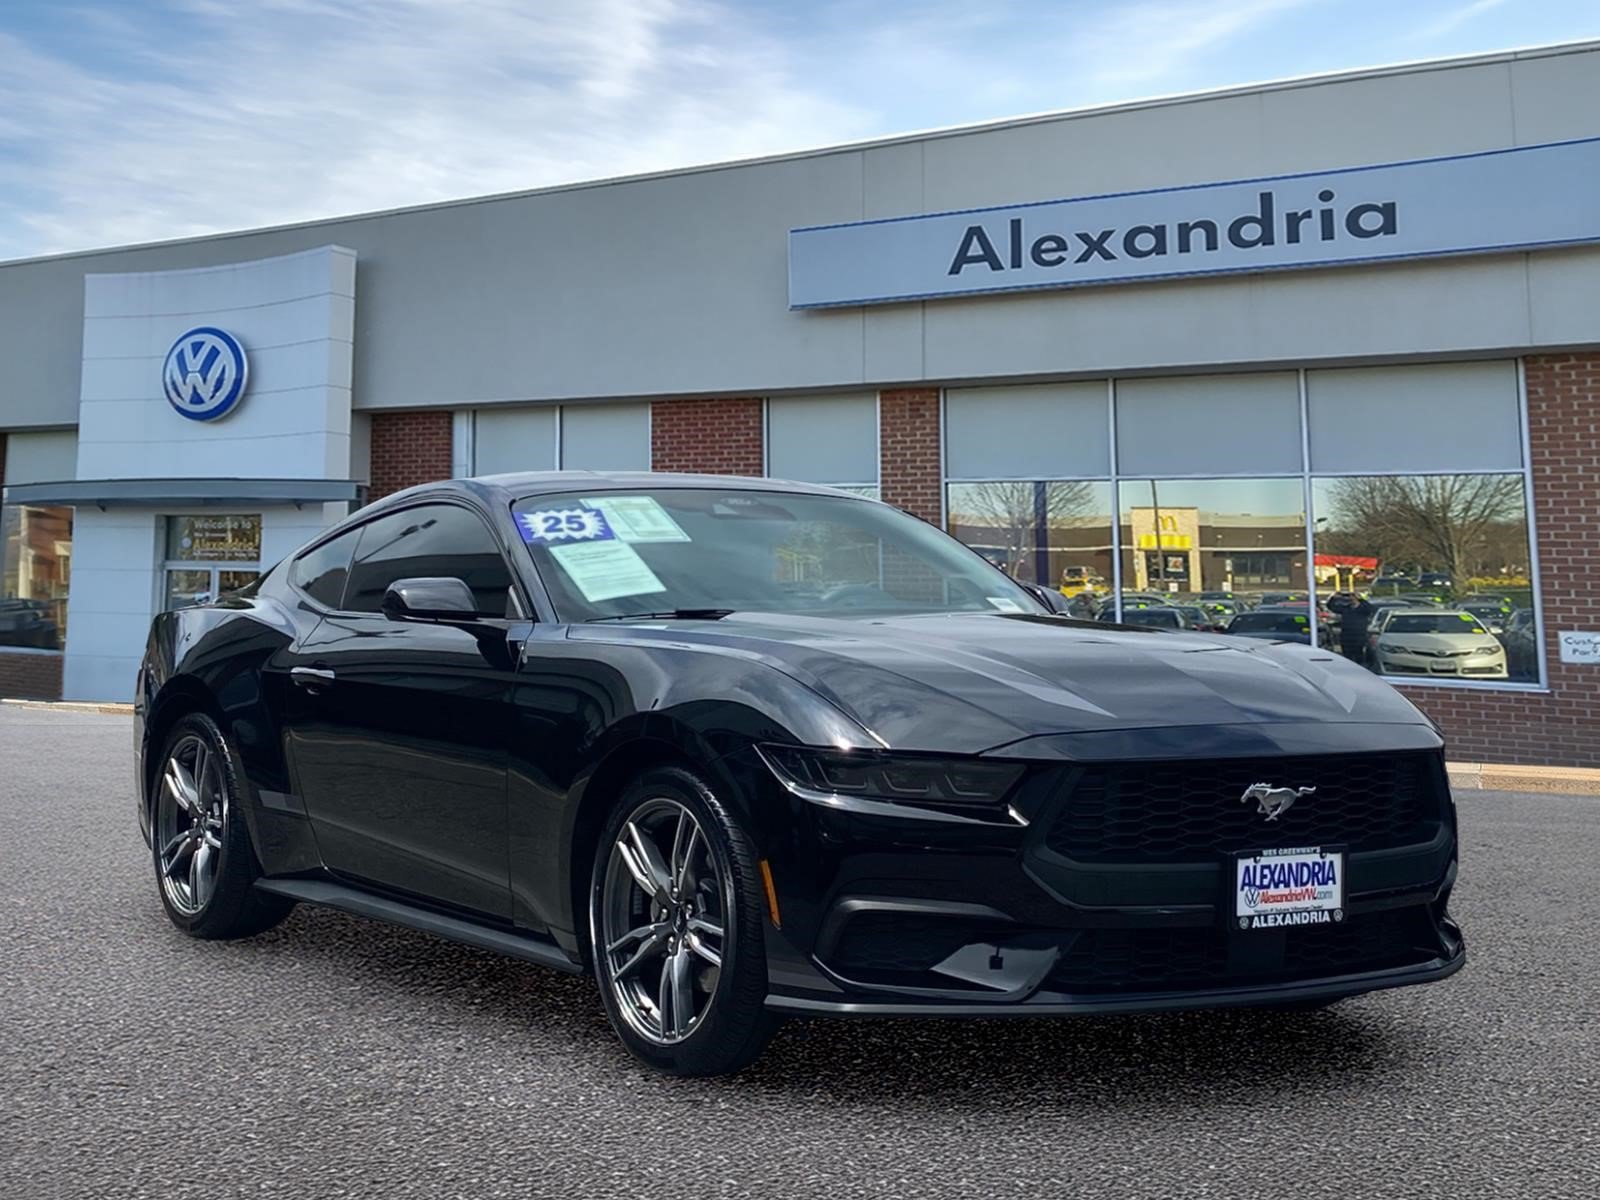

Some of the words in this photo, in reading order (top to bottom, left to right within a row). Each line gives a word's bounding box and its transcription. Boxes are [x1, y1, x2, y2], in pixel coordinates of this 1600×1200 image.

[947, 191, 1398, 276] Alexandria
[541, 515, 586, 533] 25
[1240, 860, 1336, 891] ALEXANDRIA
[1252, 910, 1331, 928] ALEXANDRIA
